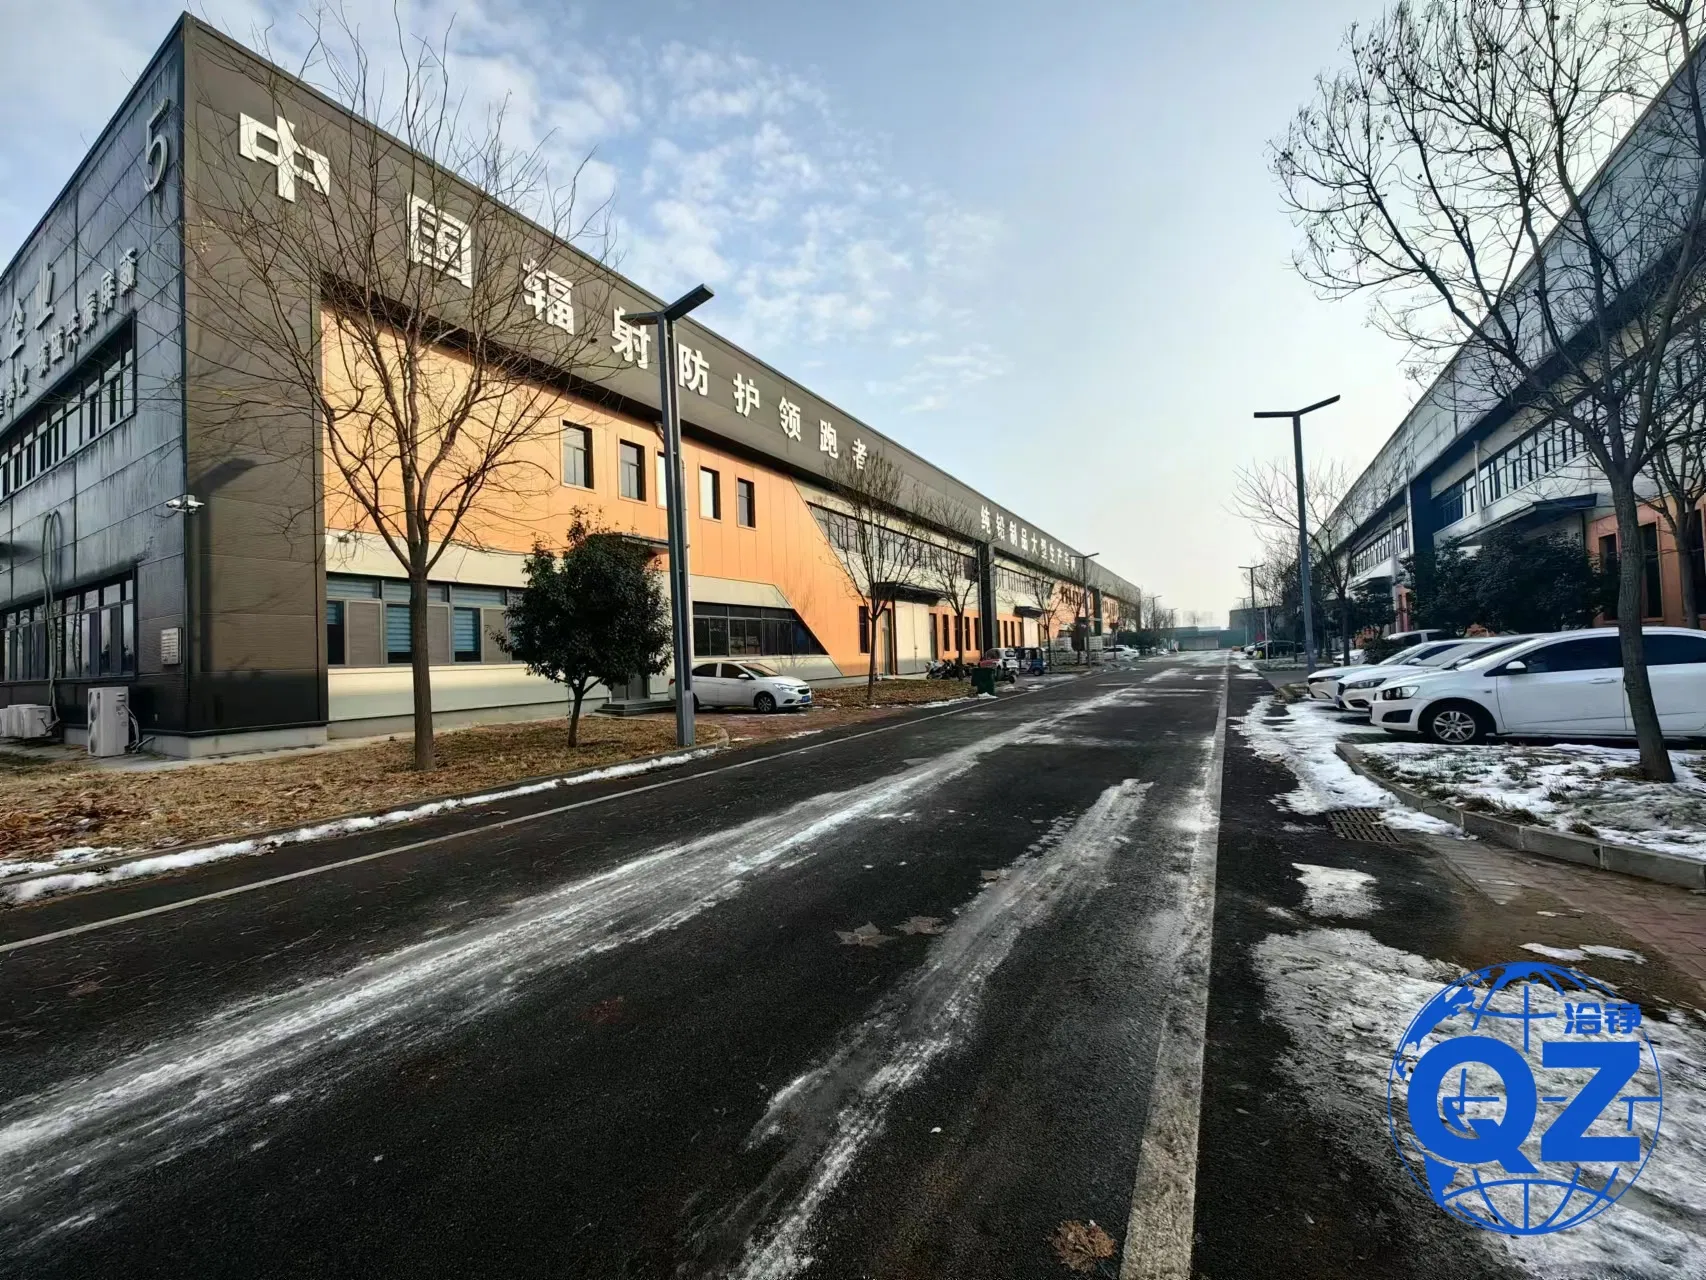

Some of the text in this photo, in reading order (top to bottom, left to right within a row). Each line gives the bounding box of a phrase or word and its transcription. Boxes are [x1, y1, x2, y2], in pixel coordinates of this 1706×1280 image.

[144, 96, 169, 191] 5
[239, 112, 867, 469] 中国辐射防护领跑者
